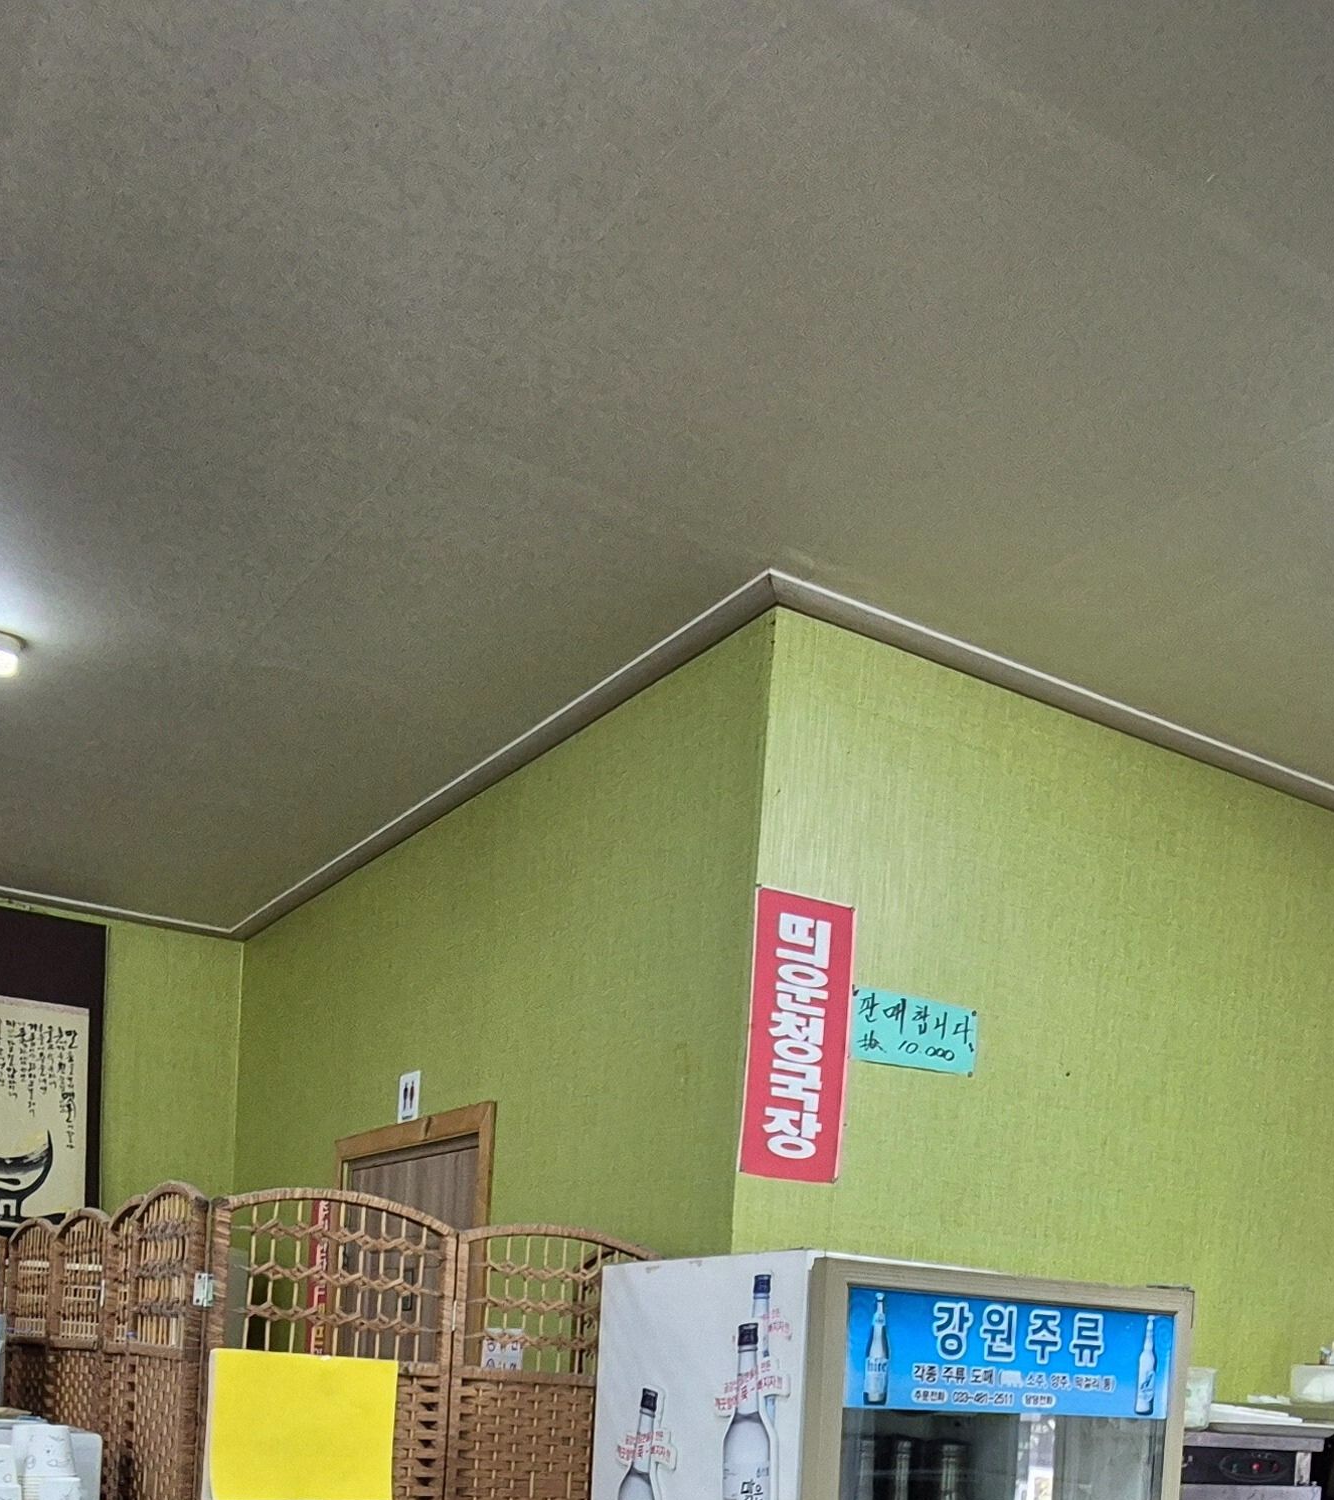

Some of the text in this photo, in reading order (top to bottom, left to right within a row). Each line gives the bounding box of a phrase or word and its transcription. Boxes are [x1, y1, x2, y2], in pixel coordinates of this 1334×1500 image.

[934, 1303, 1105, 1366] 강원주류
[914, 1365, 937, 1383] 각종
[942, 1366, 965, 1384] 주류
